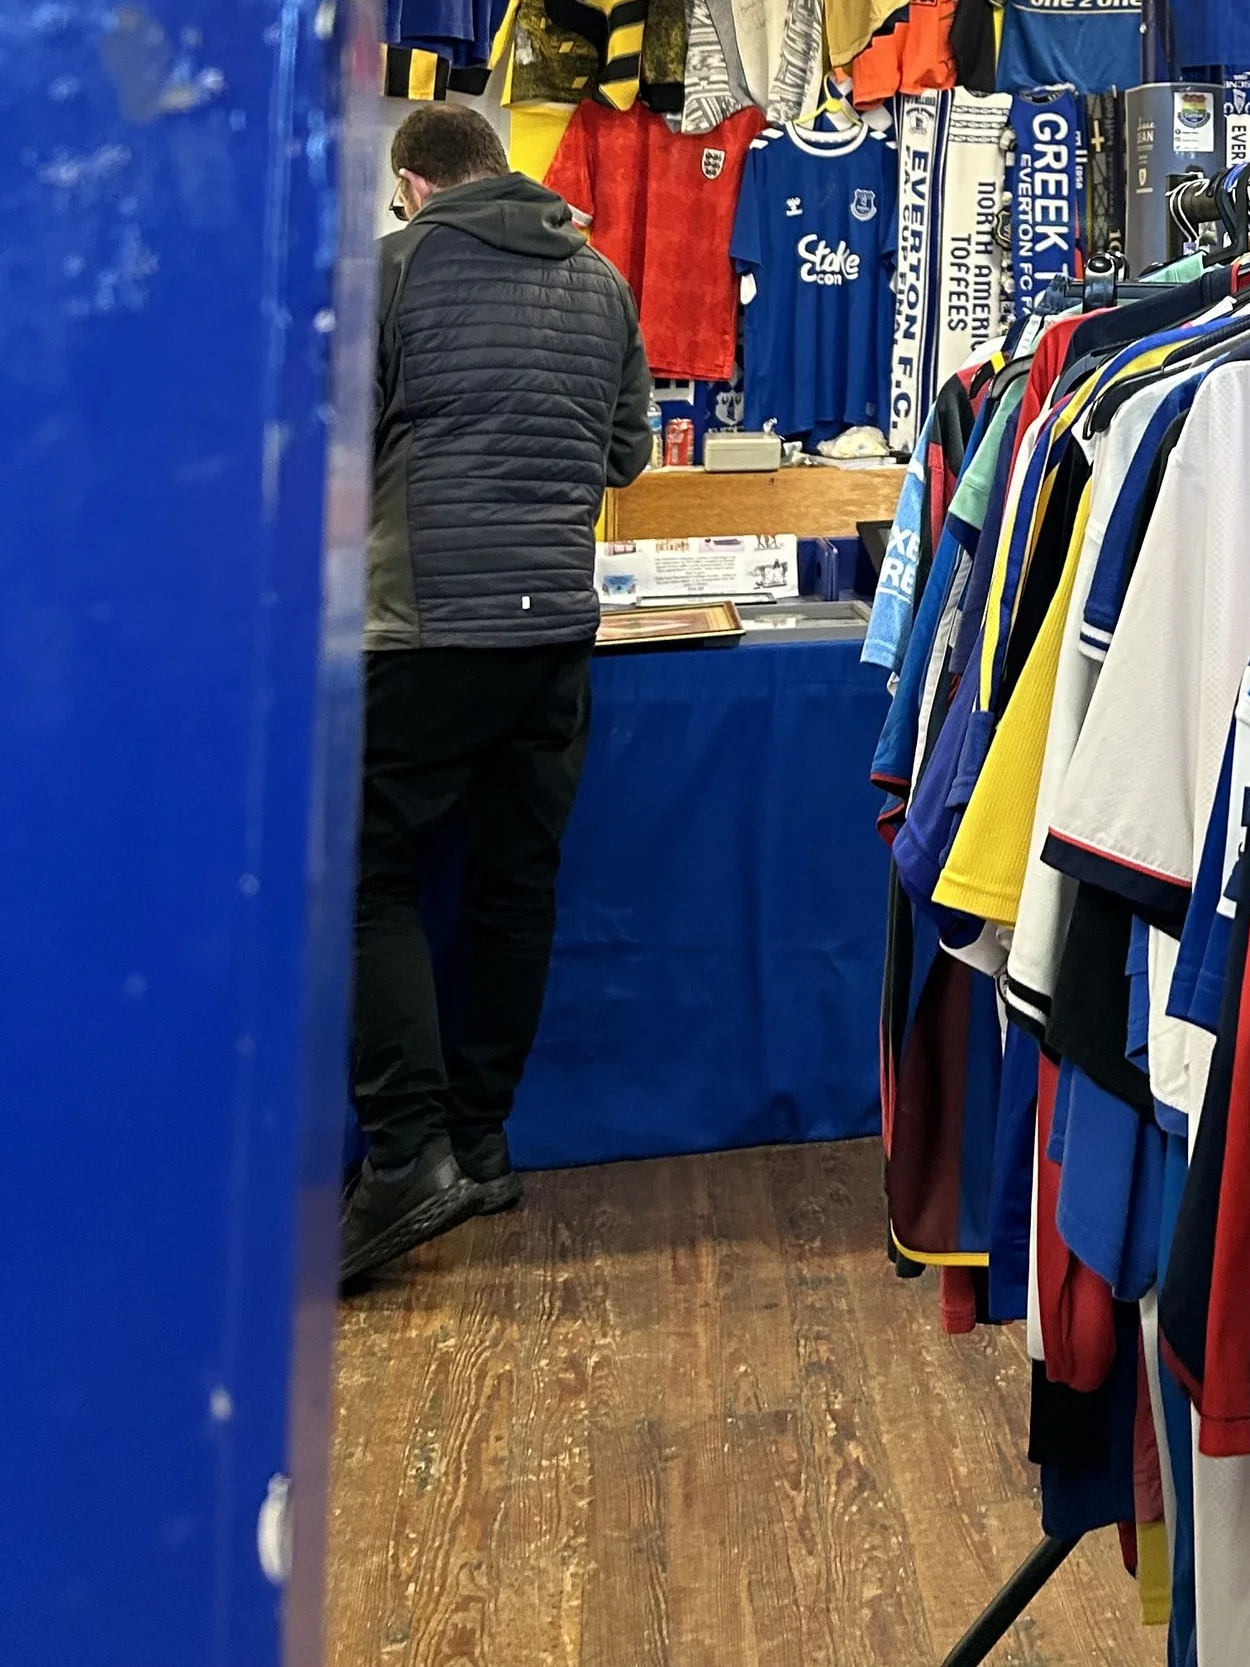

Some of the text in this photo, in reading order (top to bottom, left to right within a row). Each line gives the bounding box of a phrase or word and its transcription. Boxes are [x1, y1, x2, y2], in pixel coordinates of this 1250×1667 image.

[1032, 112, 1070, 253] GREEK
[1230, 125, 1247, 166] EVER
[974, 181, 997, 255] NORTH
[1017, 153, 1033, 257] EVERTON
[797, 233, 860, 283] Stake
[892, 149, 929, 430] EVERTON F.C.
[947, 233, 973, 332] TOFFEES
[1019, 262, 1033, 291] FC
